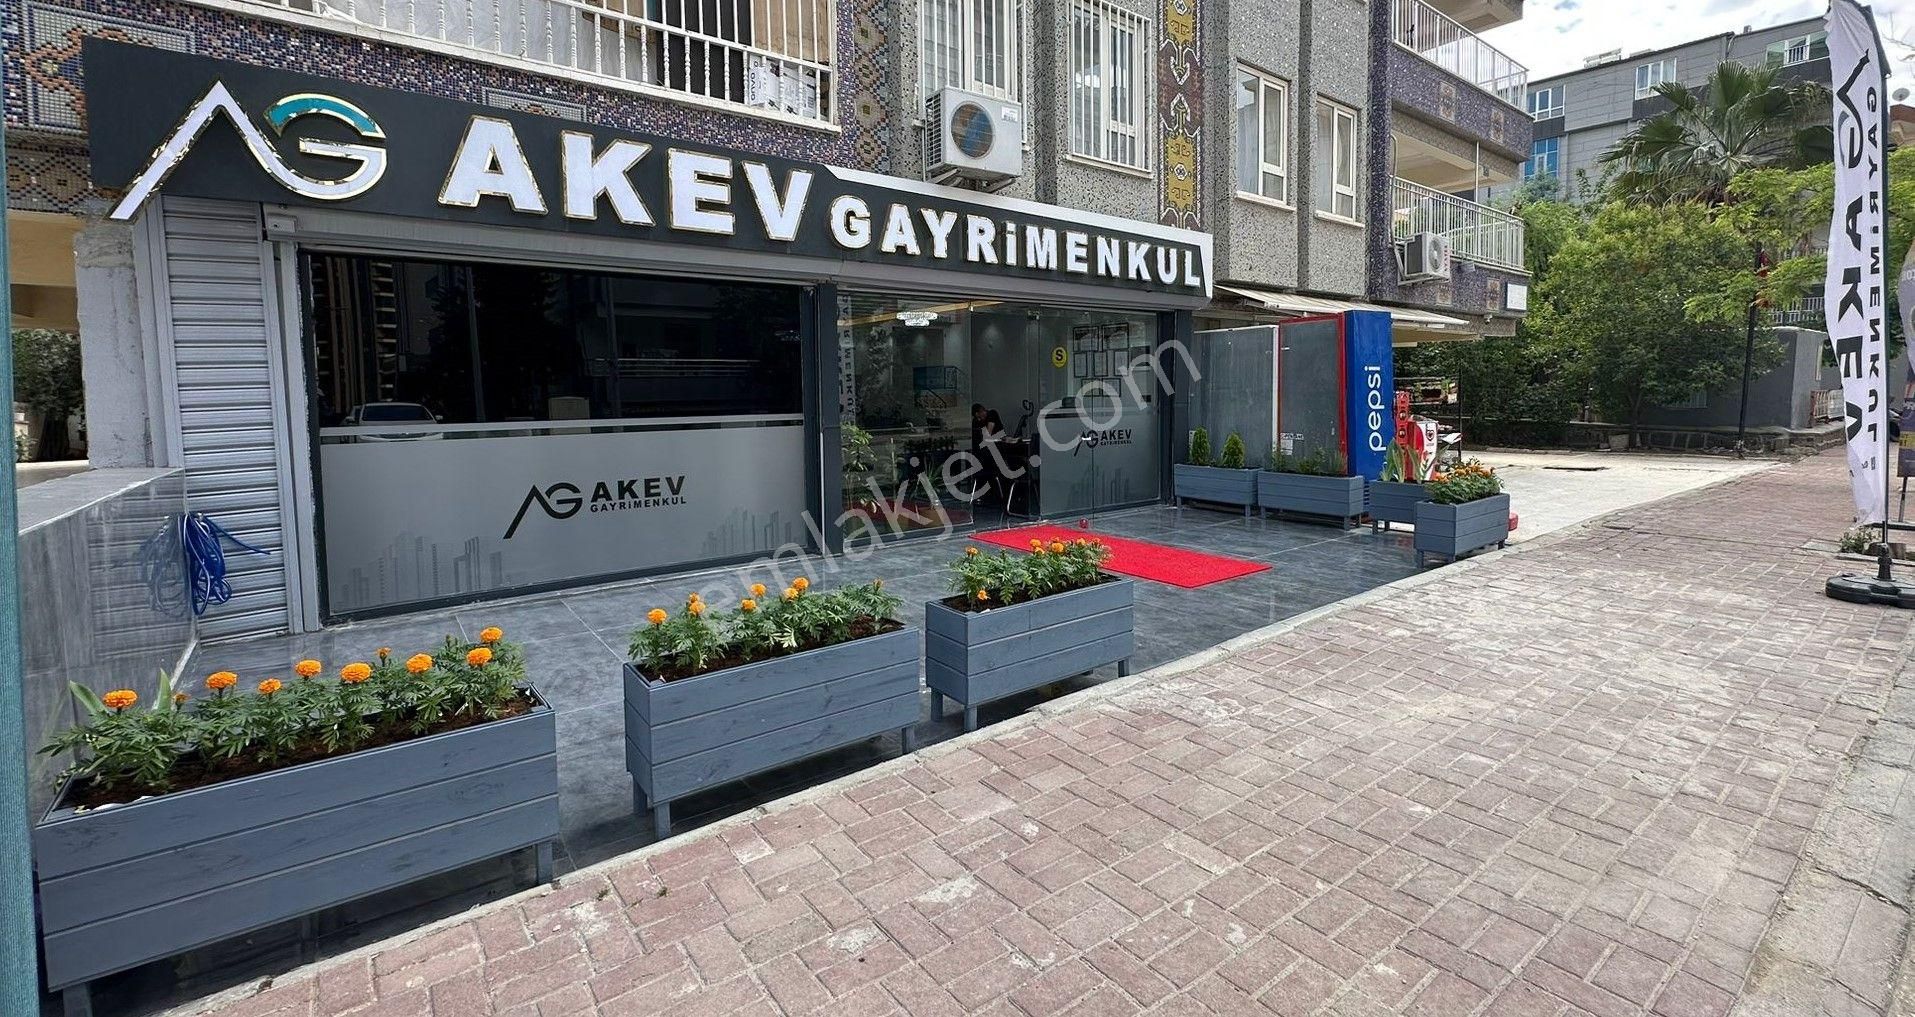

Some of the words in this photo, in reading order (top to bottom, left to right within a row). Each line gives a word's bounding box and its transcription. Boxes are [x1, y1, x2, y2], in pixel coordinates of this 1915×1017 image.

[438, 115, 813, 241] AKEV
[1056, 349, 1063, 361] S
[1364, 366, 1386, 452] pepsi
[1101, 429, 1131, 441] AKEV
[590, 475, 686, 503] AKEV
